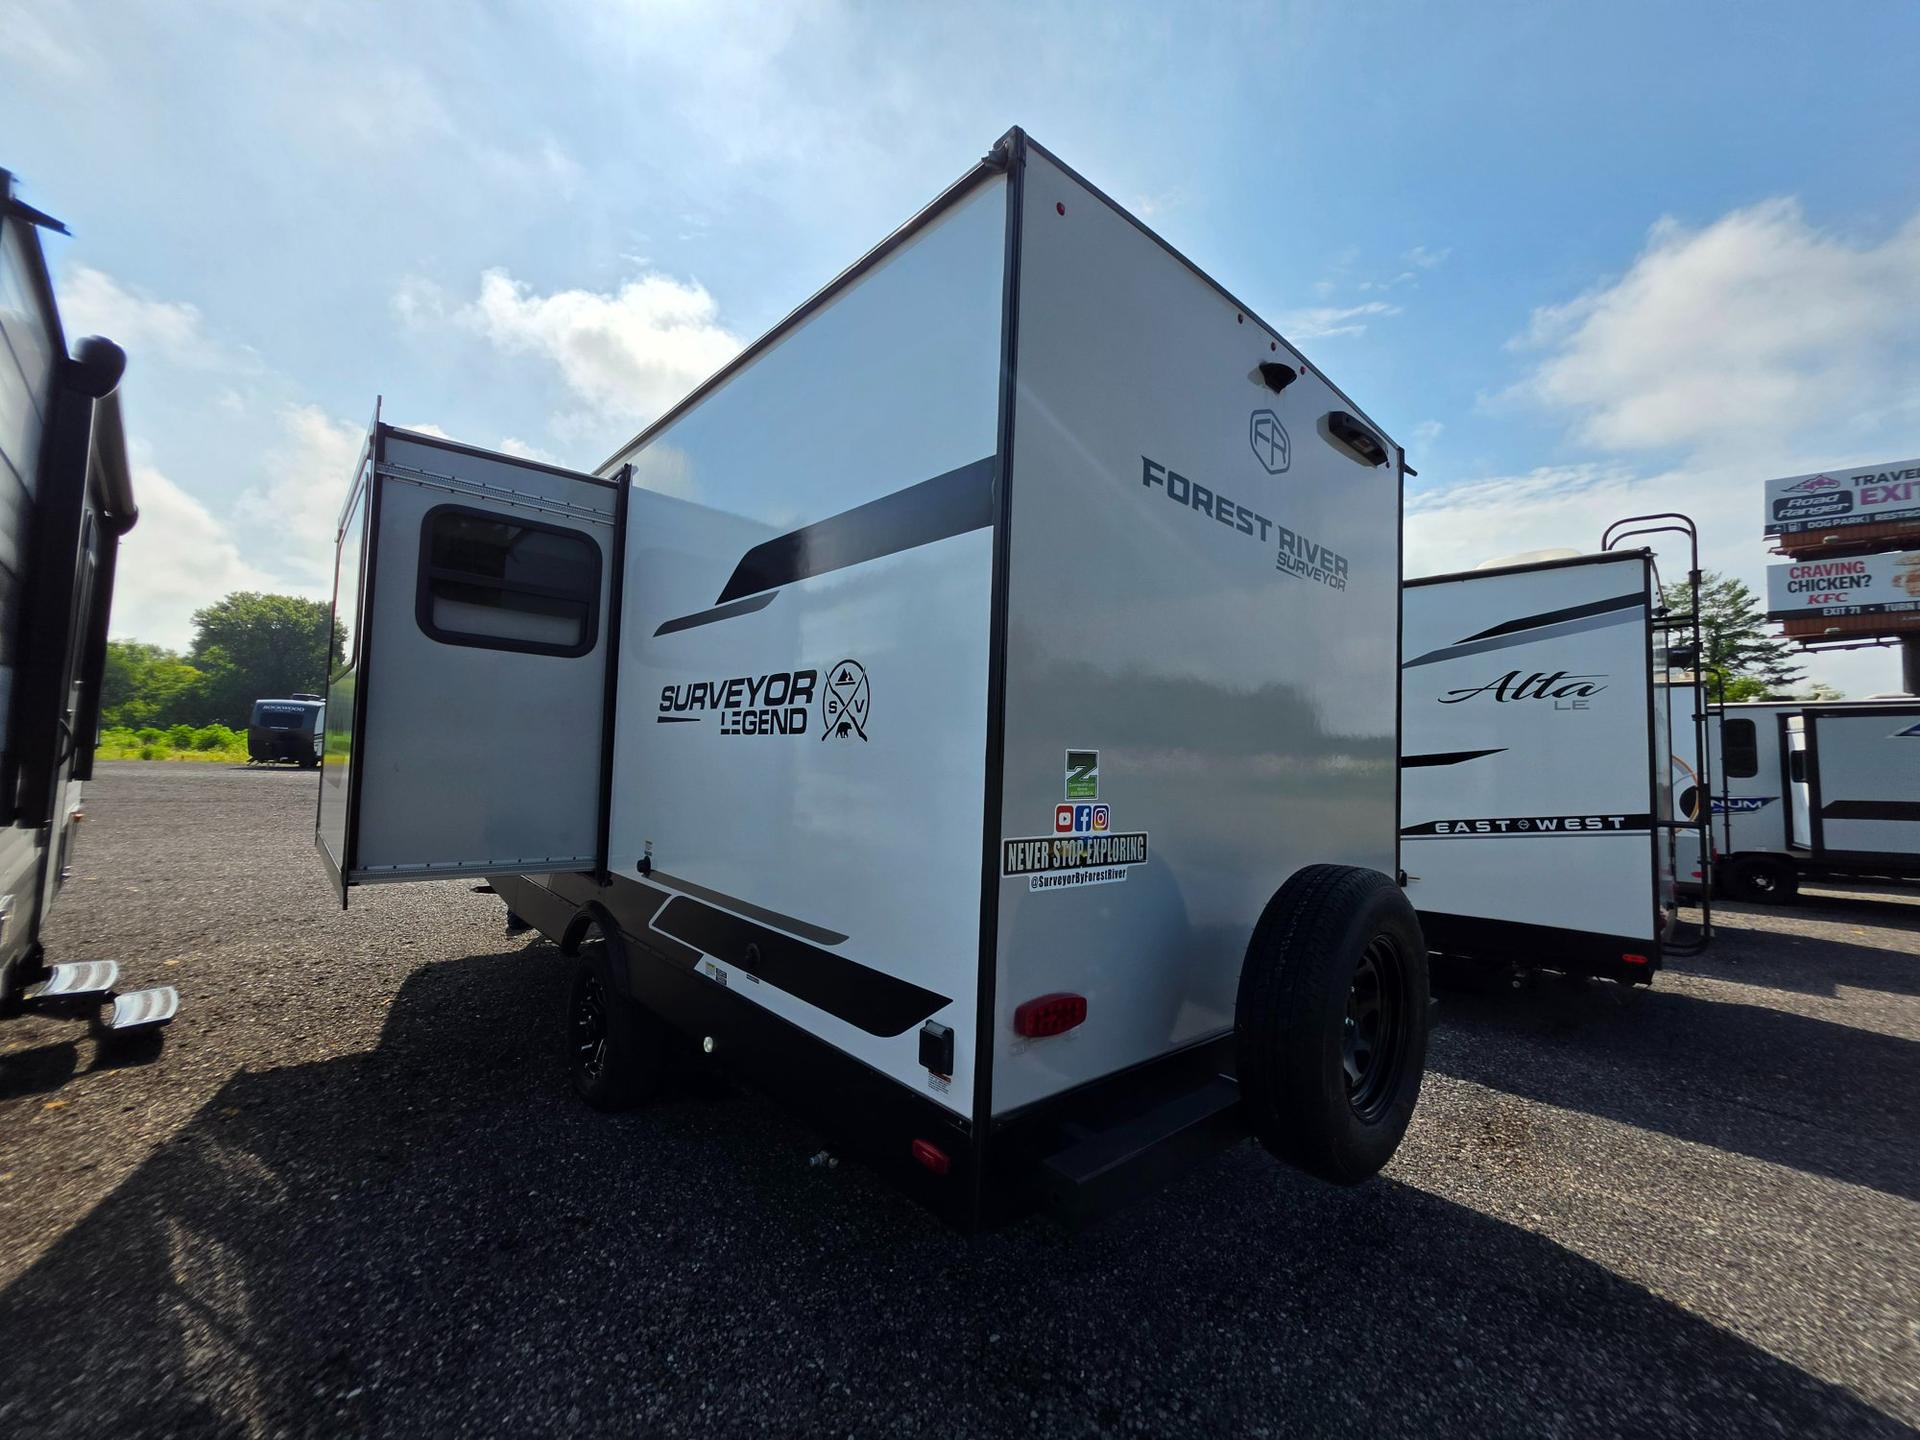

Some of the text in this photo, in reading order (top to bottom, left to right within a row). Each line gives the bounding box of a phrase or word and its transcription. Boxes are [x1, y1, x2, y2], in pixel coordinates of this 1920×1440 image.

[1787, 494, 1840, 508] Road
[1141, 455, 1349, 580] FOREST RIVER
[1778, 503, 1850, 518] Ranger
[1807, 520, 1832, 529] DOG
[1276, 551, 1346, 592] SURVEYOR
[1789, 561, 1865, 580] CRAVING
[1787, 575, 1872, 593] CHICKEN?
[1807, 593, 1848, 605] KFC
[1823, 607, 1846, 616] EXIT
[659, 669, 817, 712] SURVEYOR
[1438, 671, 1609, 704] Alta
[1554, 700, 1590, 710] LE
[720, 708, 808, 735] LEGEND
[1711, 800, 1763, 809] NUM
[1435, 817, 1625, 833] EAST WEST
[1008, 836, 1144, 871] NEVER STOP EXPLORING
[1031, 868, 1126, 888] @SurveyorByForestRiver
